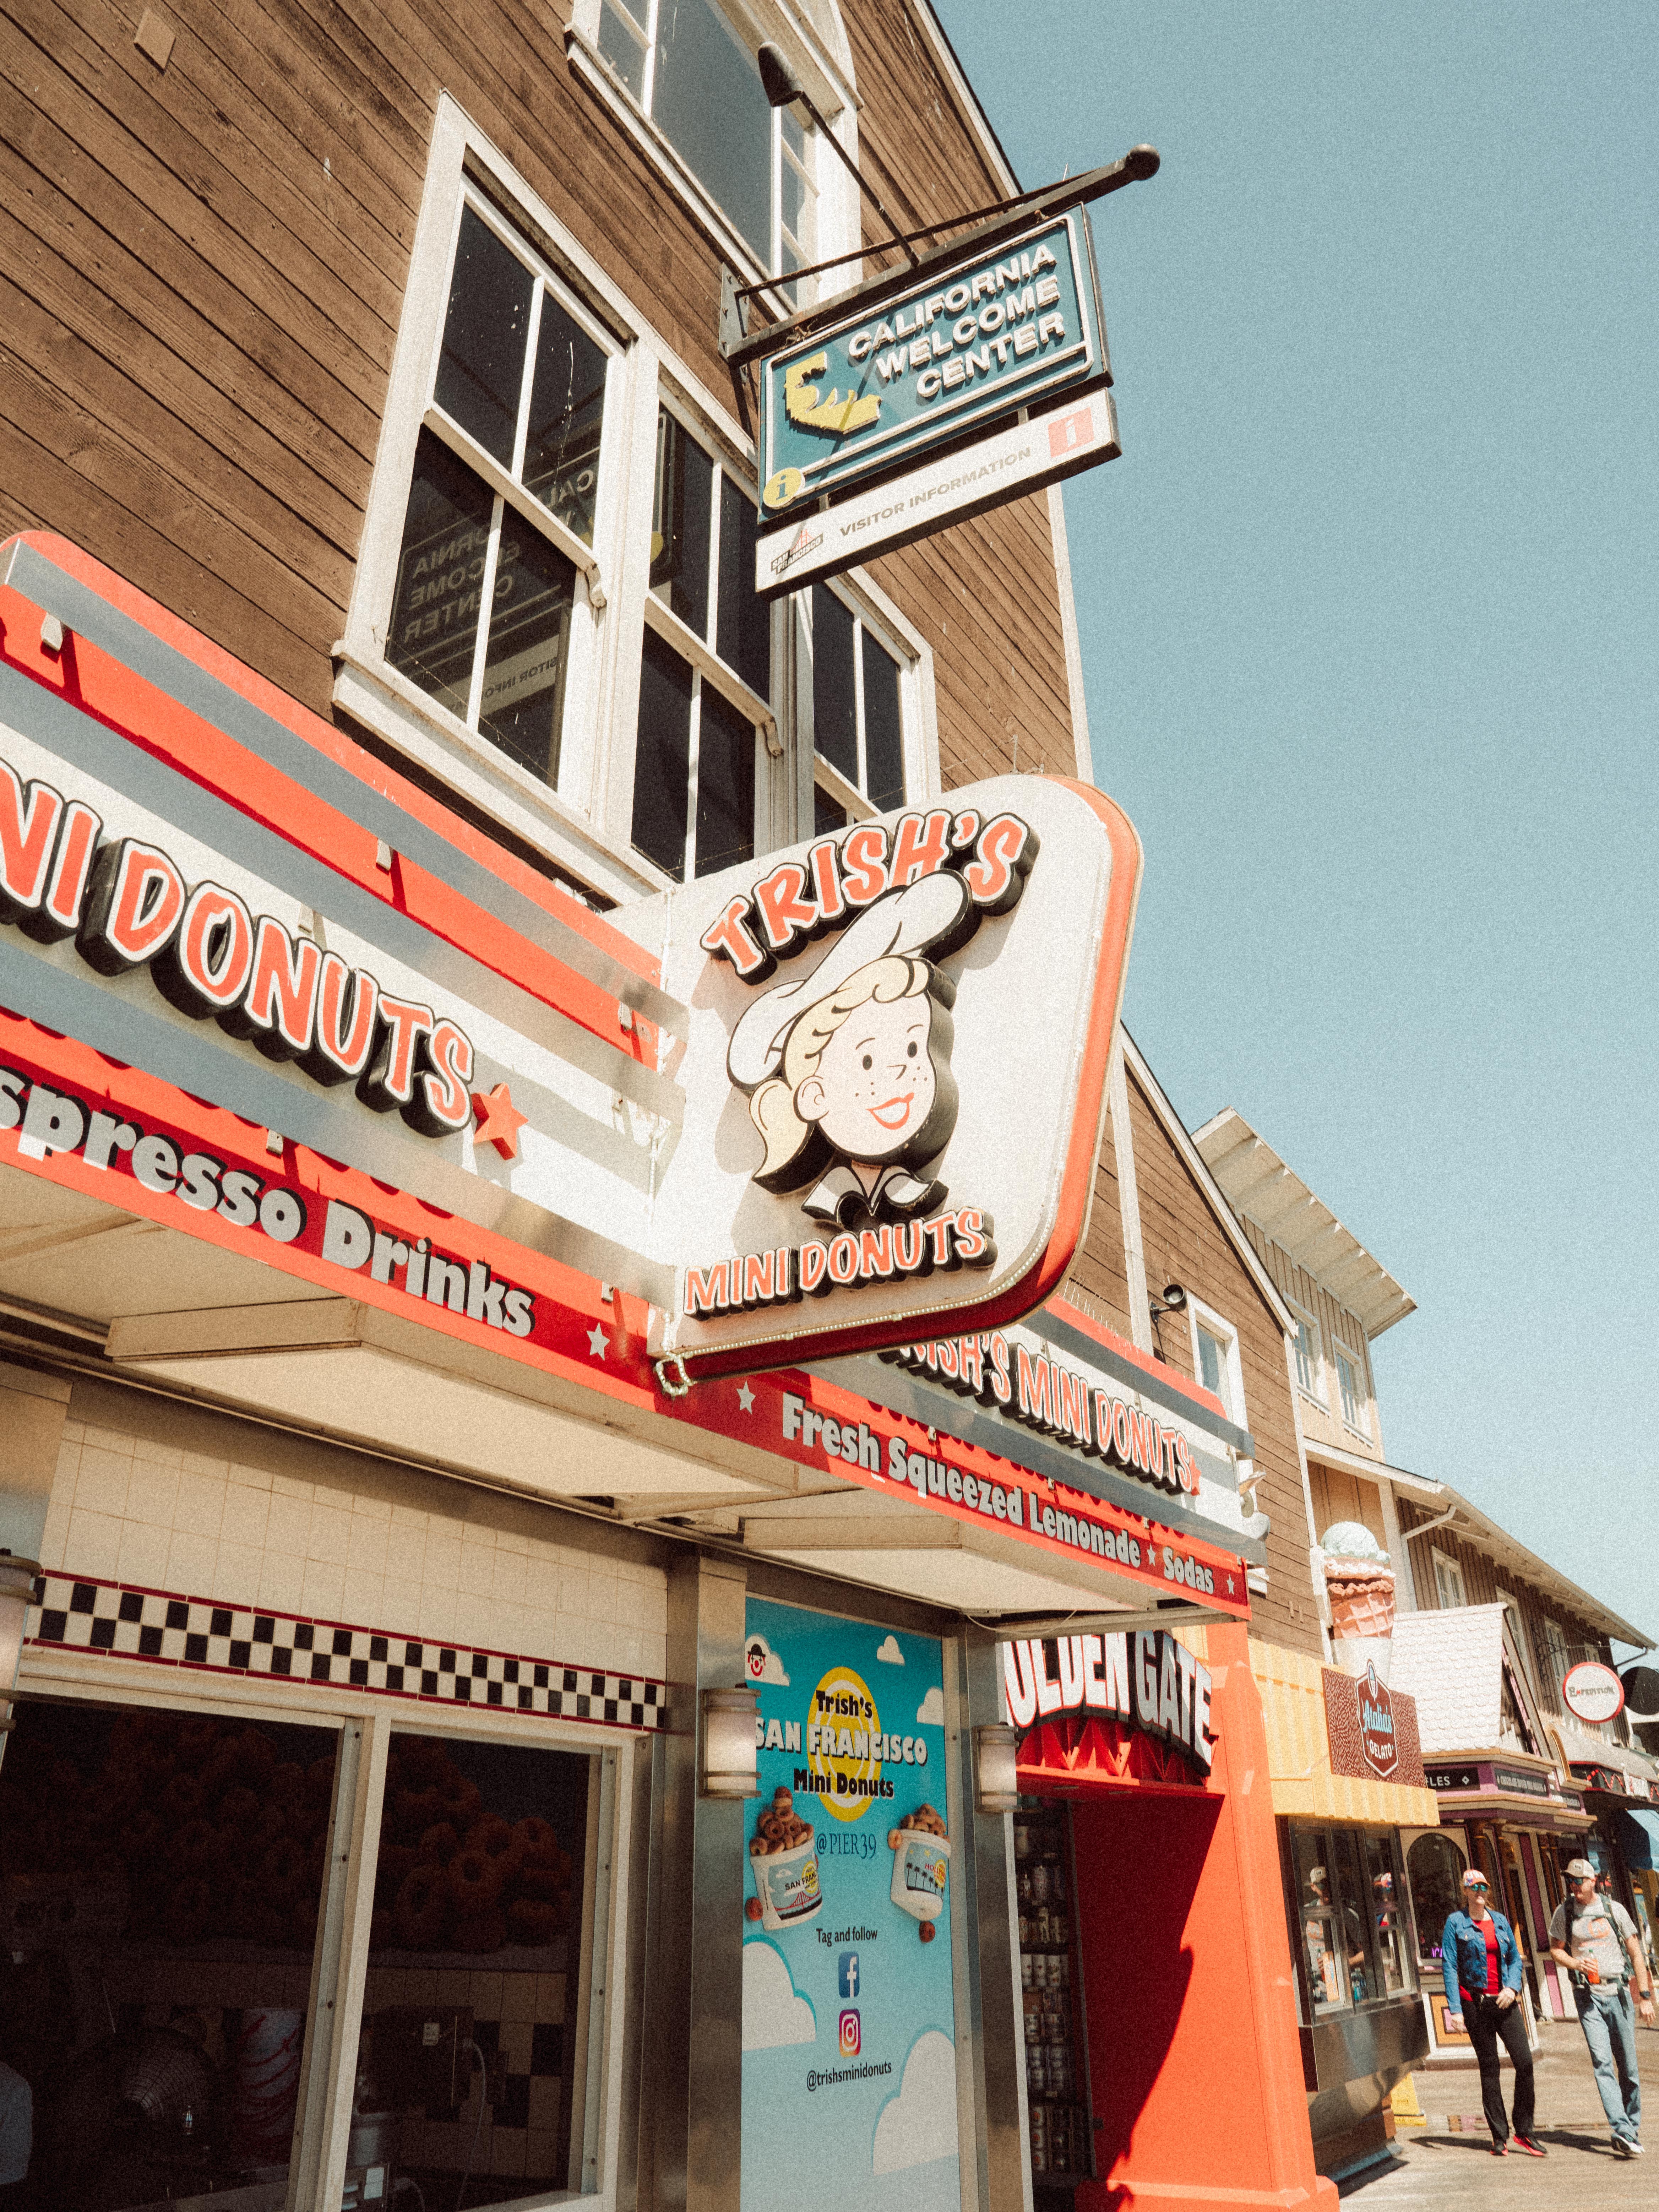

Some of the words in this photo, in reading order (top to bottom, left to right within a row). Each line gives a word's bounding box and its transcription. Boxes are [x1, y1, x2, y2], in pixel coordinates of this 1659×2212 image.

[848, 244, 1057, 357] CALIFORNIA
[876, 275, 1060, 381] WELCOME
[917, 312, 1065, 398] CENTER
[839, 502, 904, 537] VISITOR
[909, 447, 1031, 508] INFORMATION
[772, 551, 788, 570] SAN
[777, 537, 821, 574] FRANCISCO
[701, 809, 1030, 977] TRISH'S
[105, 839, 474, 1131] DONUTS
[322, 1200, 533, 1337] Drinks
[684, 1246, 791, 1315] MINI
[800, 1208, 988, 1292] DONUTS
[1017, 1342, 1091, 1443] MINI
[1095, 1388, 1193, 1493] DONUTS
[782, 1392, 881, 1473] Fresh
[888, 1437, 1024, 1525] Squeezed
[1030, 1494, 1141, 1567] Lemonade
[1163, 1547, 1214, 1594] Sodas
[756, 1716, 802, 1754] SAN
[808, 1723, 928, 1766] FRANCISCO
[816, 1690, 872, 1718] Trish's
[1003, 1632, 1130, 1728] OLDEN
[1136, 1630, 1212, 1767] GATE
[794, 1768, 831, 1793] Mini
[836, 1773, 894, 1799] Donuts
[1370, 1739, 1392, 1759] GELATO
[785, 1880, 800, 1890] SAN
[802, 1870, 817, 1885] FRANC
[816, 1928, 832, 1947] Tag
[835, 1928, 851, 1941] and
[852, 1927, 878, 1940] follow
[806, 2061, 892, 2092] @trishsminidonuts
